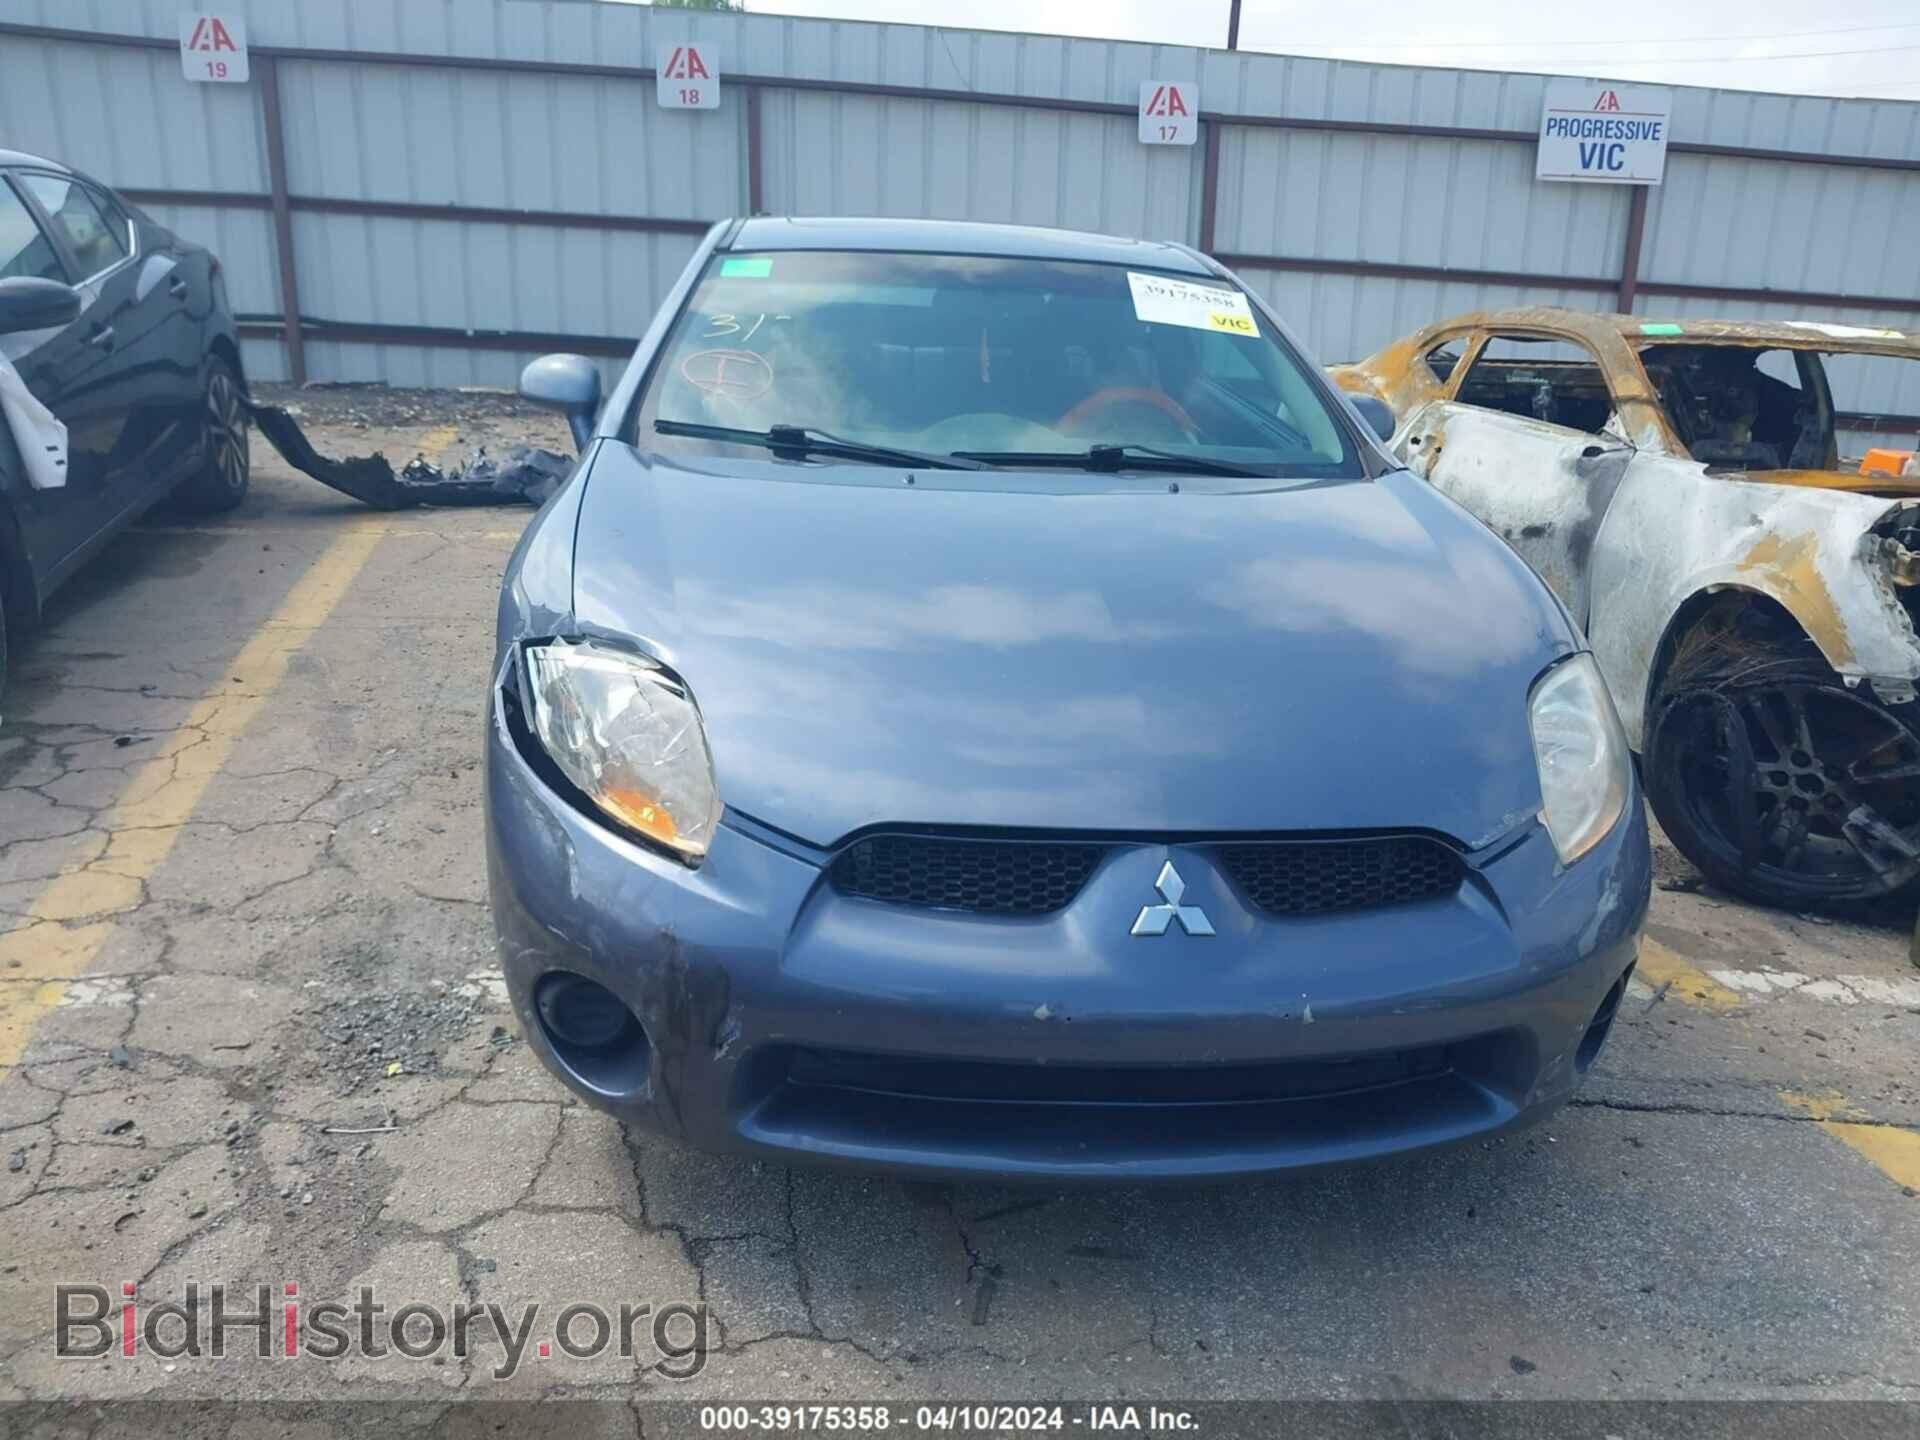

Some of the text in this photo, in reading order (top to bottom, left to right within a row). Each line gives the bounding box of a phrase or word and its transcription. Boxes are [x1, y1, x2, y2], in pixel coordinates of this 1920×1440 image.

[206, 61, 227, 78] 19
[679, 88, 700, 105] 18
[1159, 126, 1178, 141] 17
[1545, 117, 1663, 141] PROGRESSIVE
[1579, 142, 1625, 171] VIC
[1213, 315, 1251, 331] VIC
